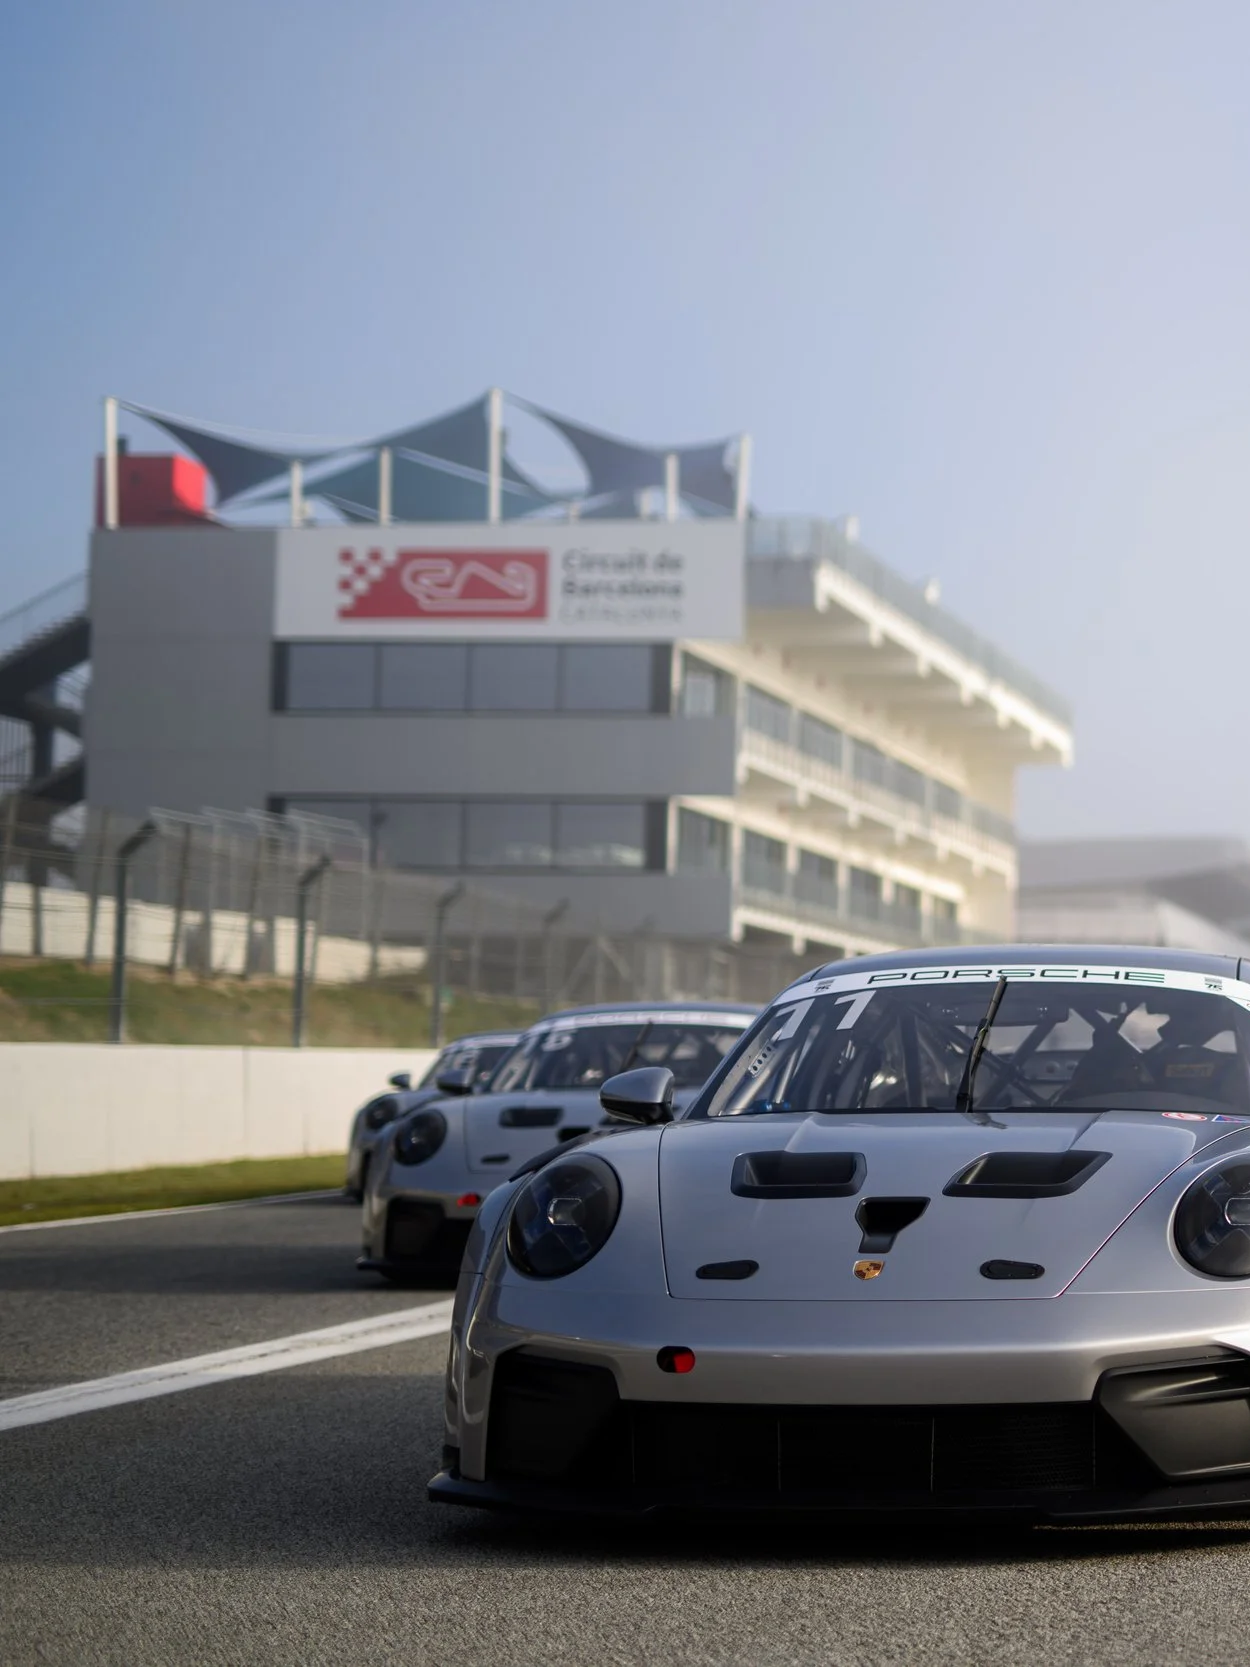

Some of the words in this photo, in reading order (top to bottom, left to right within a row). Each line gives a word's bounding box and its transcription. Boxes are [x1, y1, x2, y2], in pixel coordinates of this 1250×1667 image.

[561, 548, 647, 573] Circuit
[654, 548, 684, 573] de
[561, 575, 684, 599] Barcelona
[867, 968, 1165, 984] PORSCHE
[775, 990, 877, 1041] 11
